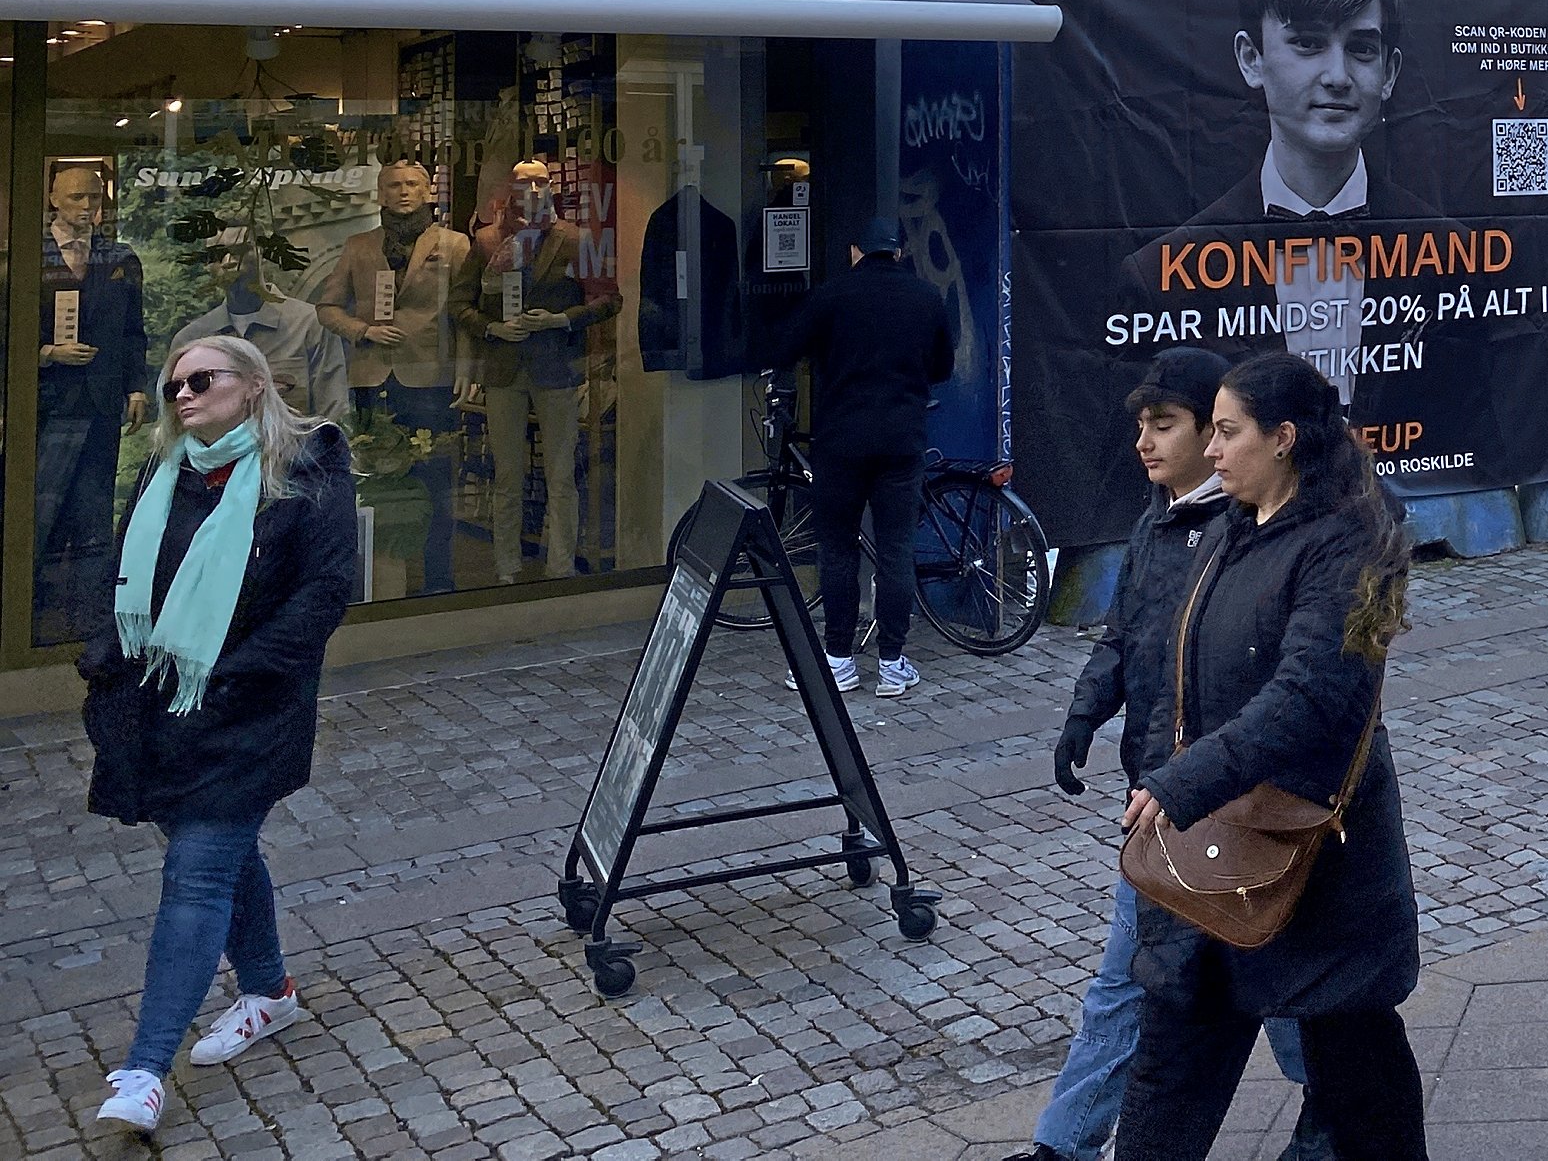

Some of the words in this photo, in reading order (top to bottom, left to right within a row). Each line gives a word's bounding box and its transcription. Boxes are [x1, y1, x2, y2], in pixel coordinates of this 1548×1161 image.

[1455, 26, 1486, 37] SCAN
[1489, 27, 1546, 39] QR-KODEN
[1451, 42, 1477, 53] KOM
[1480, 43, 1500, 54] IND
[1503, 43, 1508, 54] I
[1480, 60, 1493, 70] AT
[1497, 60, 1526, 70] HØRE
[1161, 229, 1513, 292] KONFIRMAND
[1105, 310, 1202, 346] SPAR
[1217, 298, 1349, 337] MINDST
[1360, 294, 1426, 327] 20%
[1438, 285, 1473, 320] PÅ
[1483, 287, 1532, 316] ALT
[1541, 285, 1548, 313] I
[1400, 452, 1474, 473] ROSKILDE
